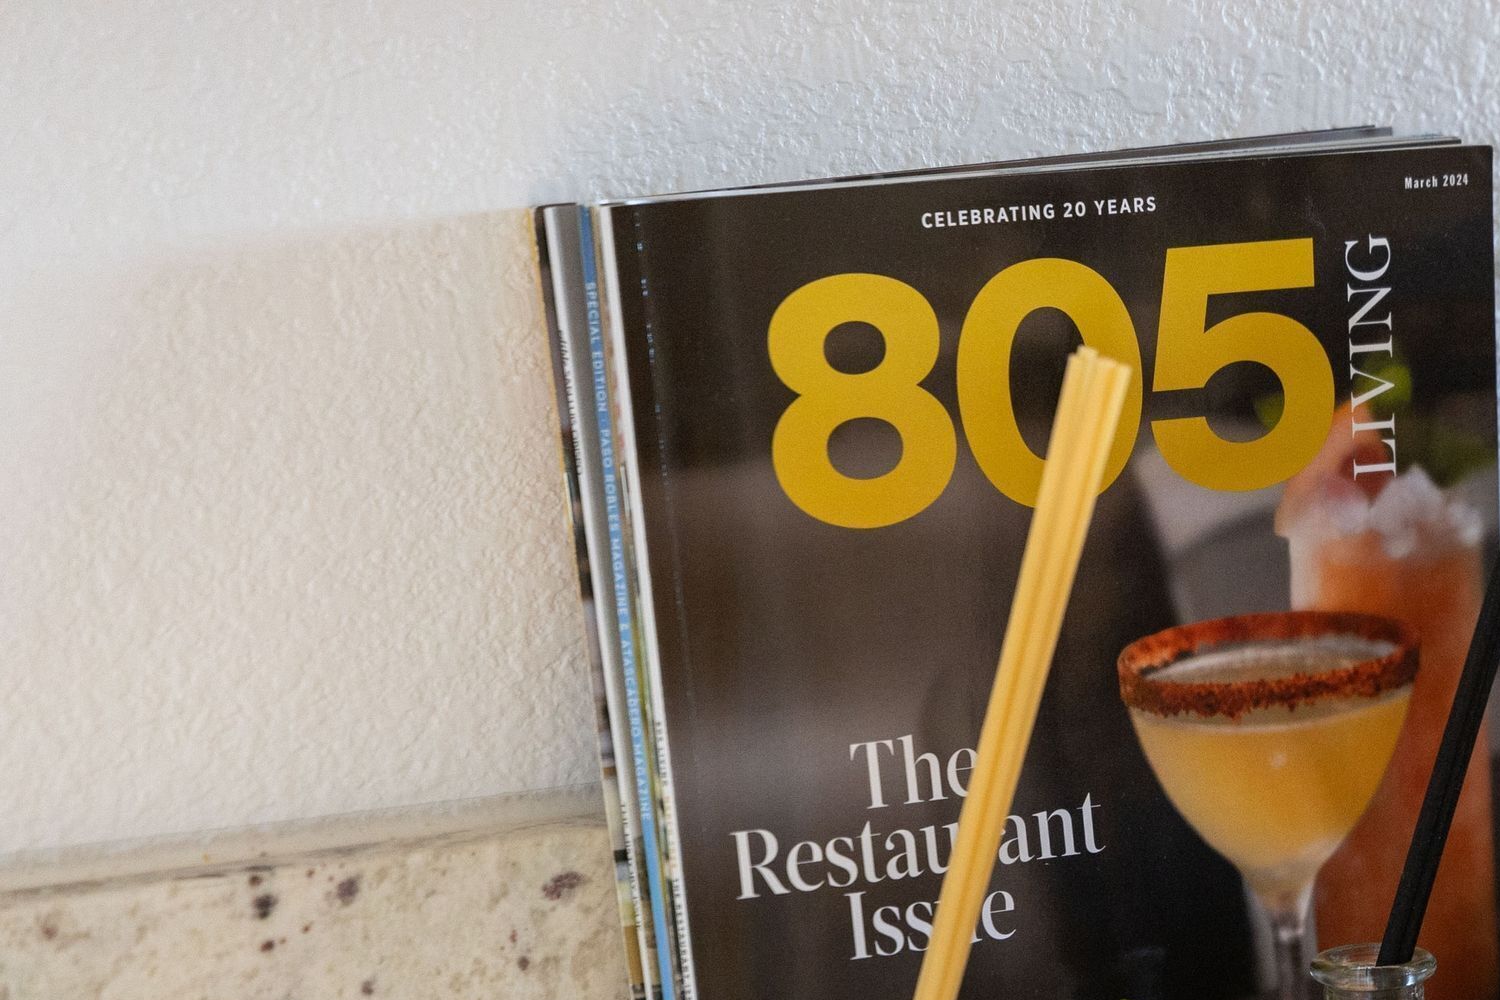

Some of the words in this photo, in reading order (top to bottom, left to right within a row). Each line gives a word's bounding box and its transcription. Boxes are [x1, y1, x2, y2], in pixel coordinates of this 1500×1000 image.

[921, 203, 1056, 229] CELEBRATING
[1063, 201, 1087, 218] 20
[1093, 196, 1157, 216] YEARS
[1404, 175, 1438, 190] March
[1442, 172, 1469, 188] 2024
[586, 282, 599, 344] SPECIAL
[592, 351, 606, 412] EDITION
[766, 236, 1336, 530] 805
[1344, 232, 1398, 482] LIVING
[604, 474, 618, 531] ROBLES
[610, 538, 627, 615] MAGAZINE
[634, 743, 651, 821] MAGAZINE
[848, 733, 979, 810] The
[729, 791, 1107, 901] Restauant
[843, 887, 1018, 961] Isse
